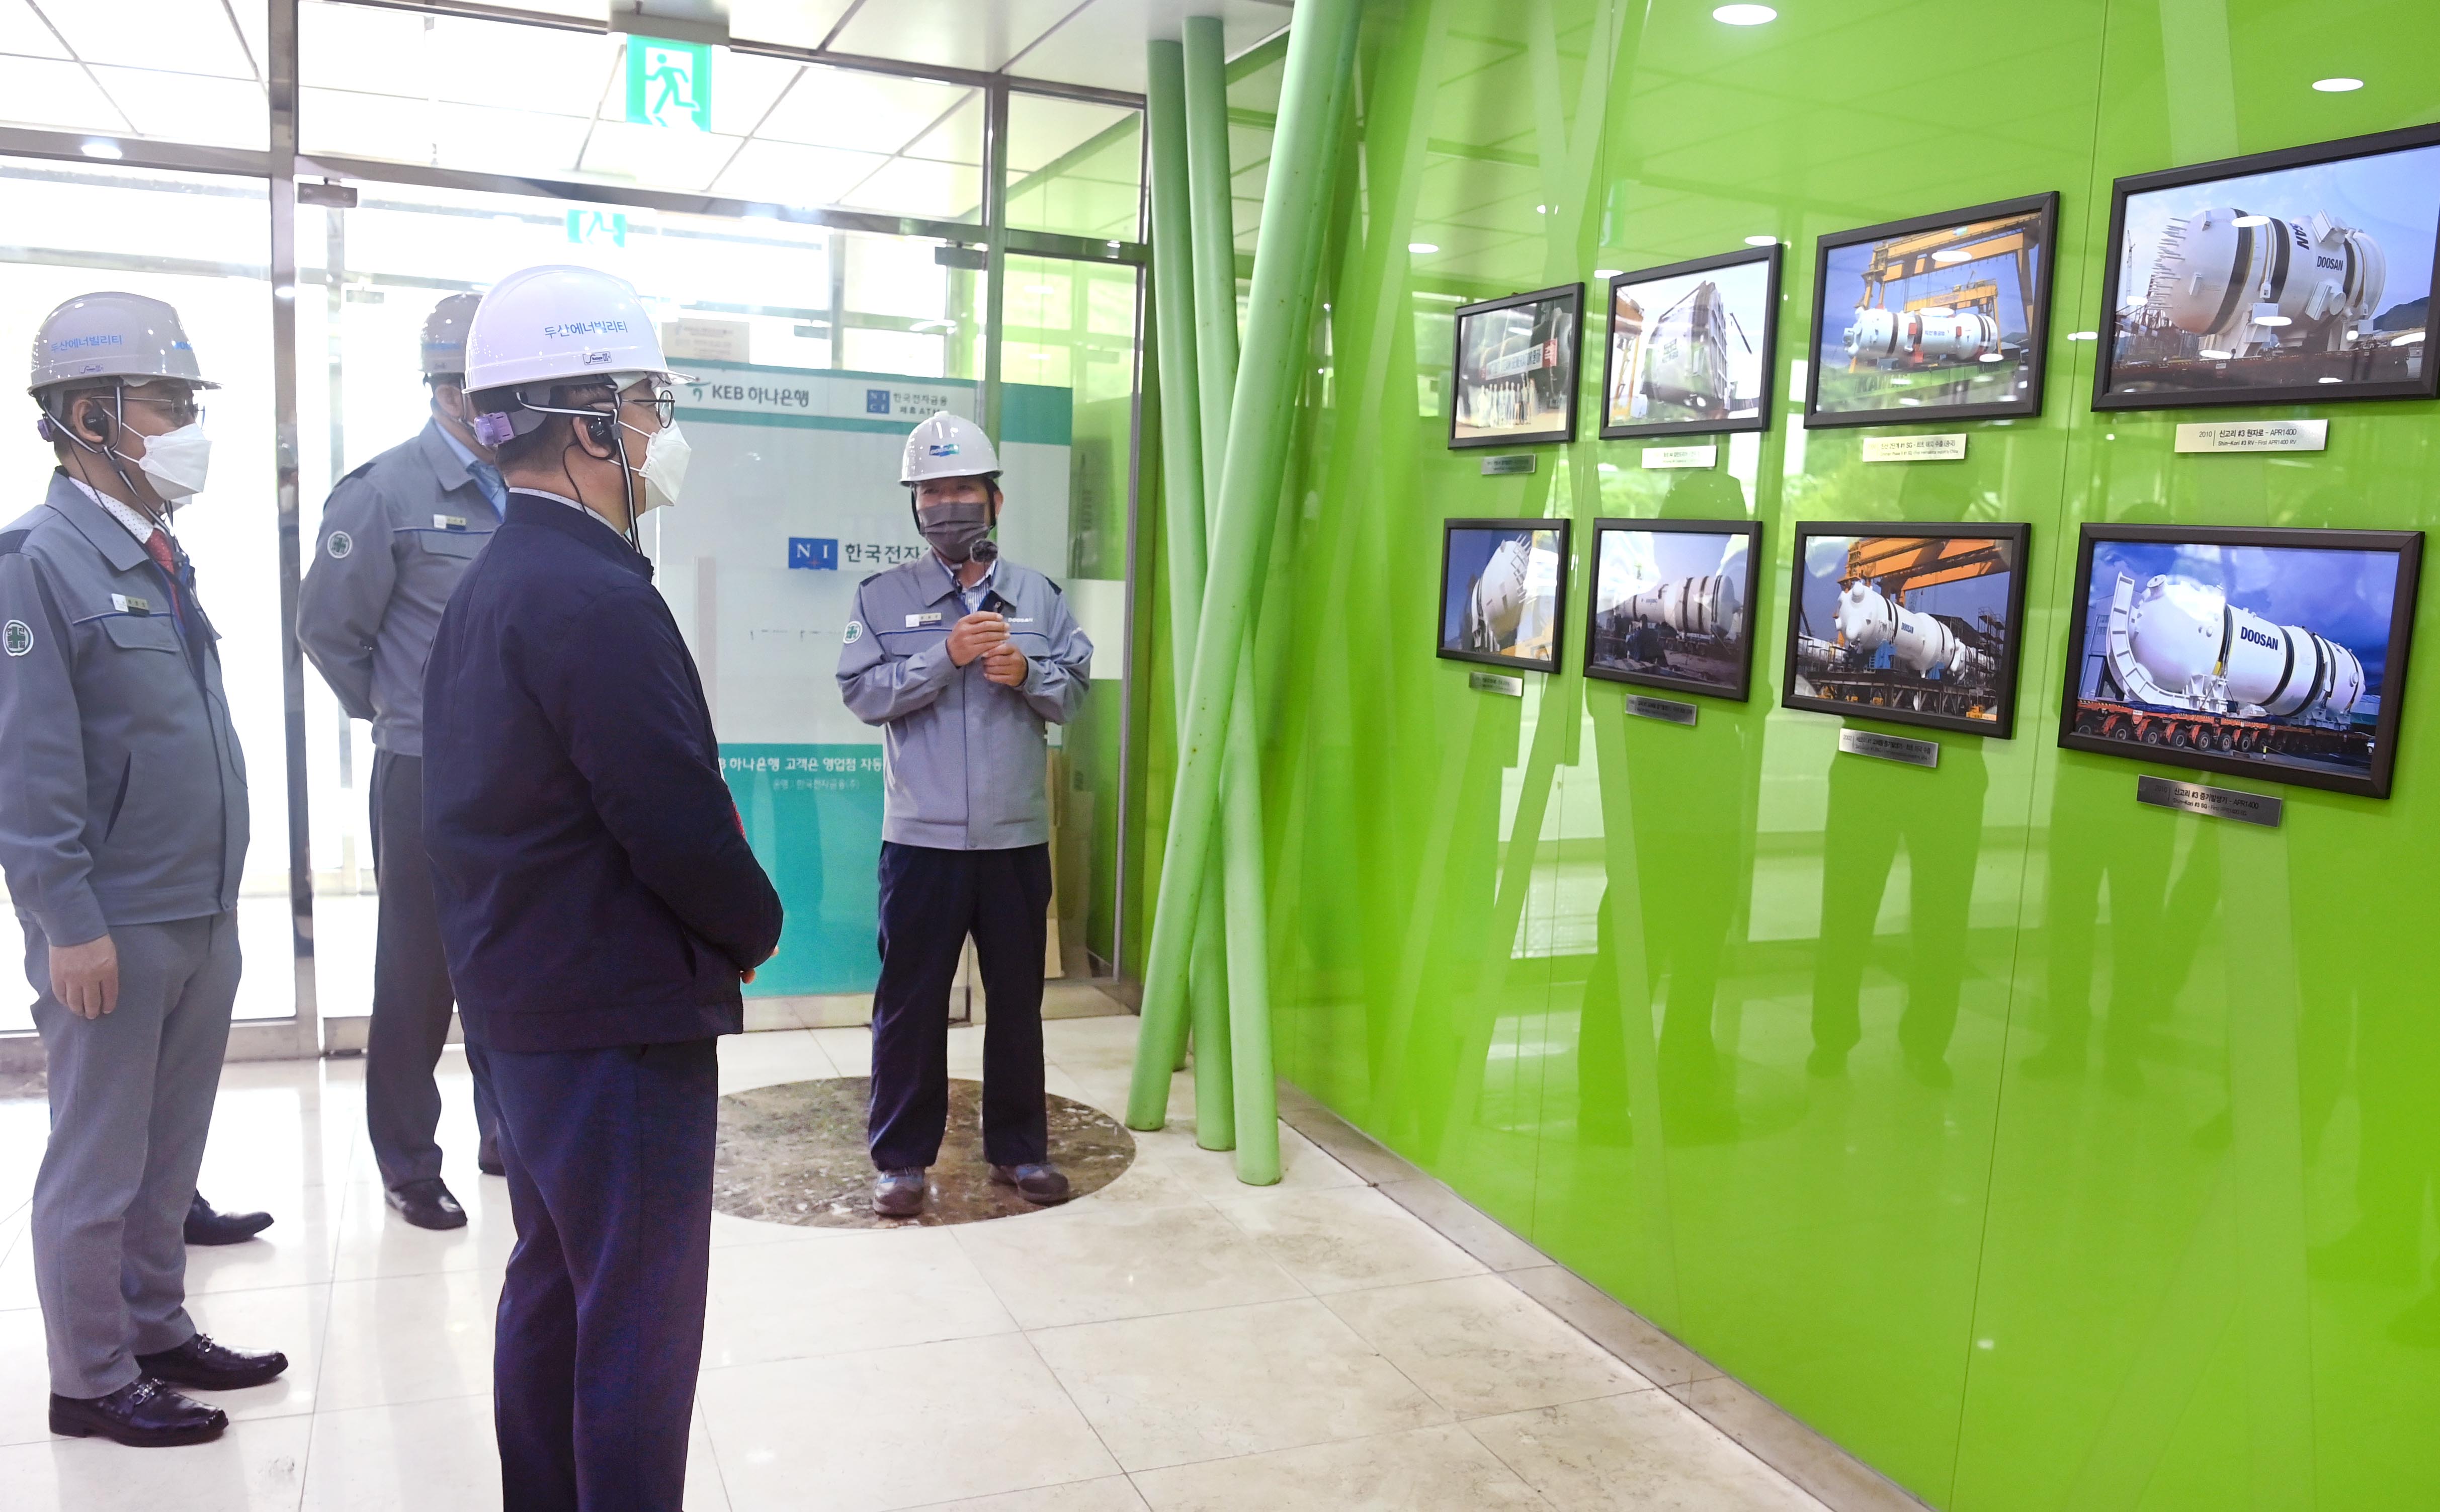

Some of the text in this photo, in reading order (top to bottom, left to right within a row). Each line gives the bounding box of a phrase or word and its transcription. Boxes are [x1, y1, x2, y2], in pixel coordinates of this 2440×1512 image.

[2317, 256, 2343, 271] DOOSAN
[544, 320, 628, 340] 두산에너빌리티
[51, 334, 122, 353] 두산에너빌리티
[712, 384, 809, 407] KEB 하나은행
[2219, 429, 2236, 438] 신고리
[2247, 429, 2264, 437] 원자로
[2270, 429, 2297, 437] APR1400
[796, 543, 829, 559] NI
[846, 543, 930, 564] 한국전자
[1901, 622, 1914, 634] DOOSAN
[2240, 626, 2278, 650] DOOSAN
[729, 757, 780, 772] 하나은행
[785, 757, 819, 772] 고객은
[822, 757, 856, 772] 영업점
[2174, 787, 2190, 797] 신고리
[2191, 791, 2199, 799] #3
[2200, 793, 2228, 804] 증기발생기
[2233, 799, 2259, 809] APR1400
